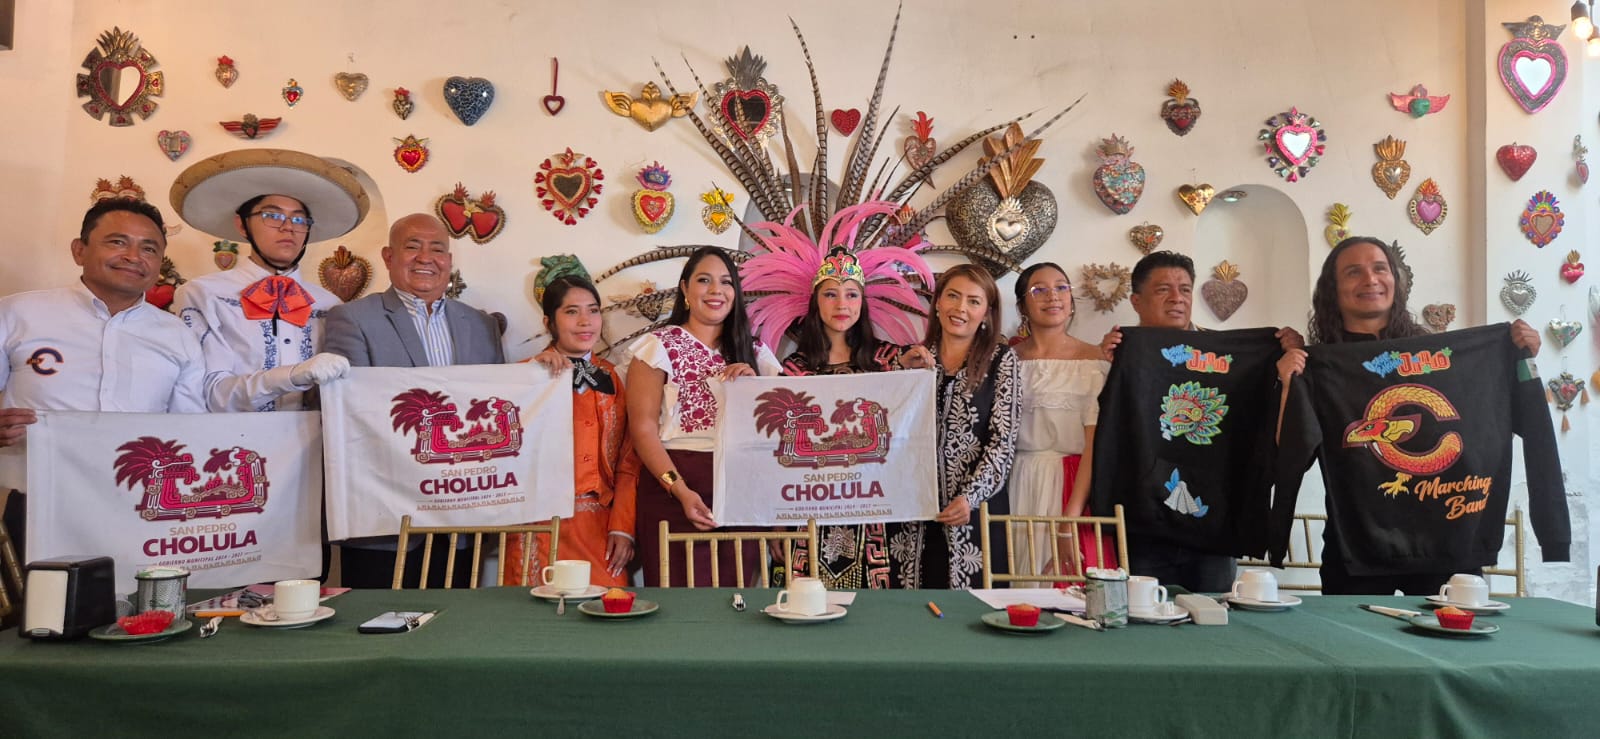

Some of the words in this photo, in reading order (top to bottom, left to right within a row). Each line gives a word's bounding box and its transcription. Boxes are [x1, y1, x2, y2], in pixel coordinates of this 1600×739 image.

[441, 469, 462, 478] SAN
[464, 465, 497, 476] PEDRO
[804, 473, 825, 482] SAN
[827, 471, 862, 481] PEDRO
[419, 471, 518, 495] CHOLULA
[781, 480, 884, 501] CHOLULA
[1414, 475, 1492, 501] Marching
[169, 526, 194, 536] SAN
[196, 522, 237, 533] PEDRO
[143, 530, 257, 557] CHOLULA
